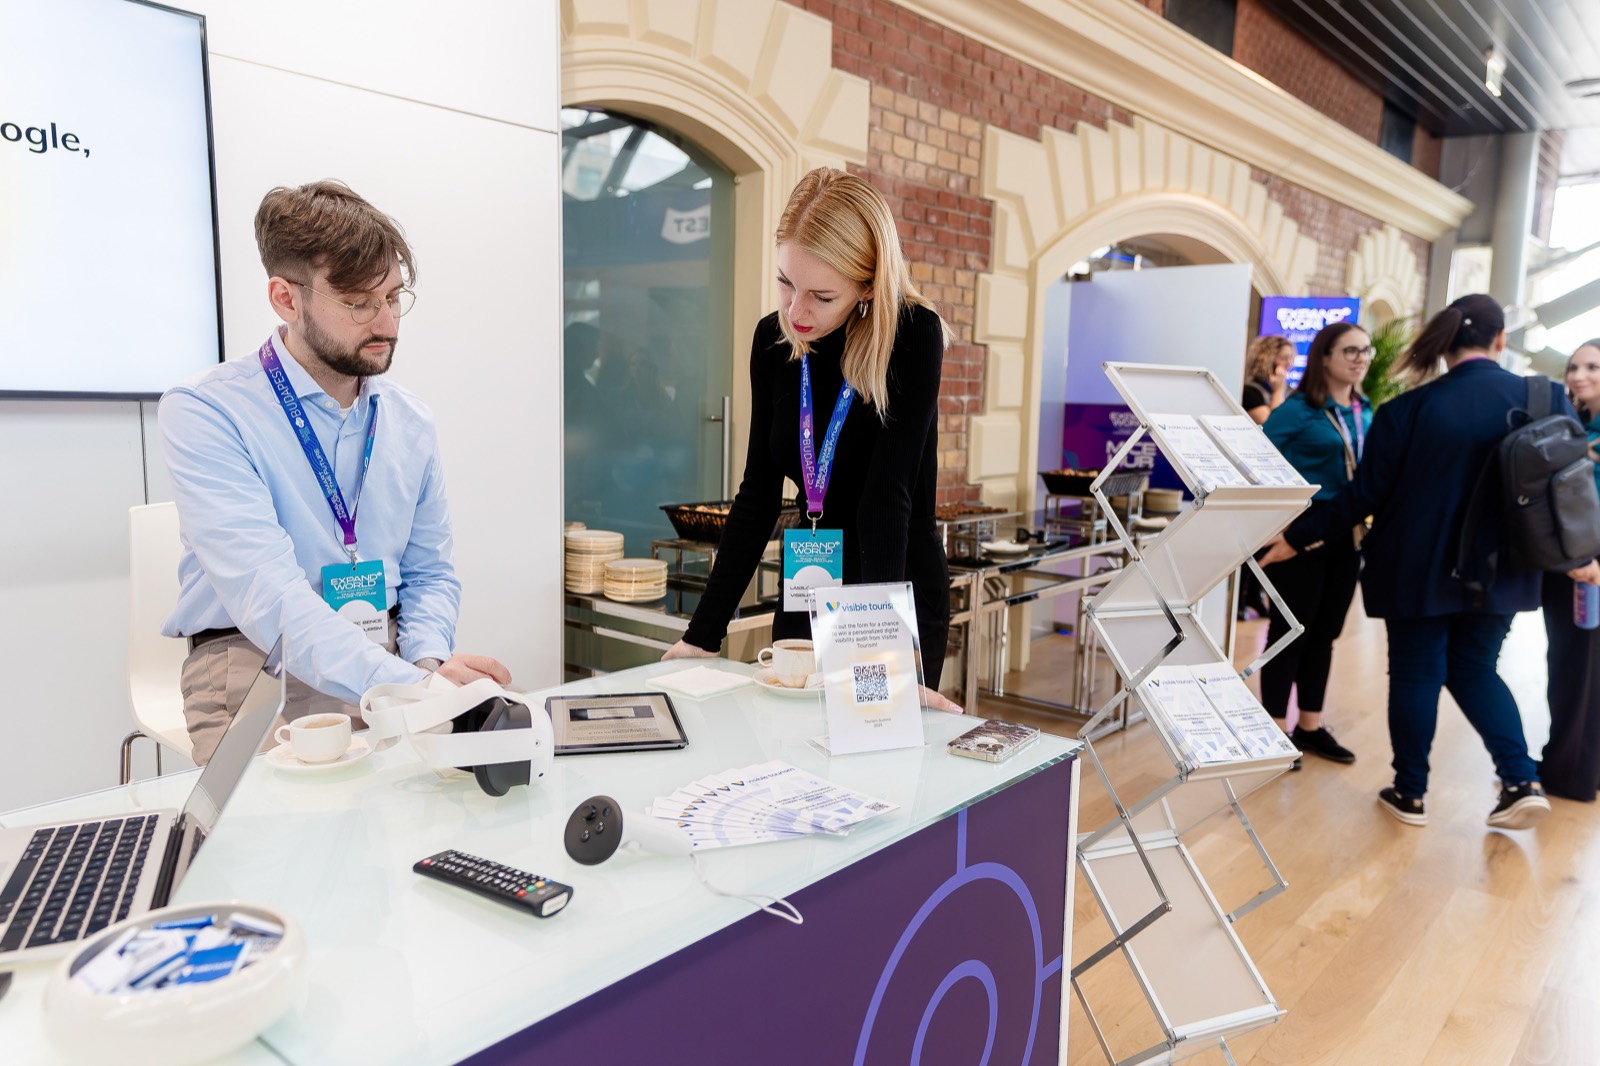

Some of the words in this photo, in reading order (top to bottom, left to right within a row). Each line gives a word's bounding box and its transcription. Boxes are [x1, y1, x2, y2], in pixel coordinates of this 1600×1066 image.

[0, 122, 90, 158] ogle,
[269, 366, 302, 418] BUDAPEST
[1106, 440, 1157, 456] MCE
[802, 438, 815, 489] BUDAPES
[790, 541, 836, 549] EXPAND
[793, 547, 834, 555] WORLD
[330, 573, 378, 586] EXPAND
[333, 580, 377, 591] WORLD
[842, 602, 868, 612] visible
[869, 600, 894, 611] touris
[852, 628, 883, 636] personalized
